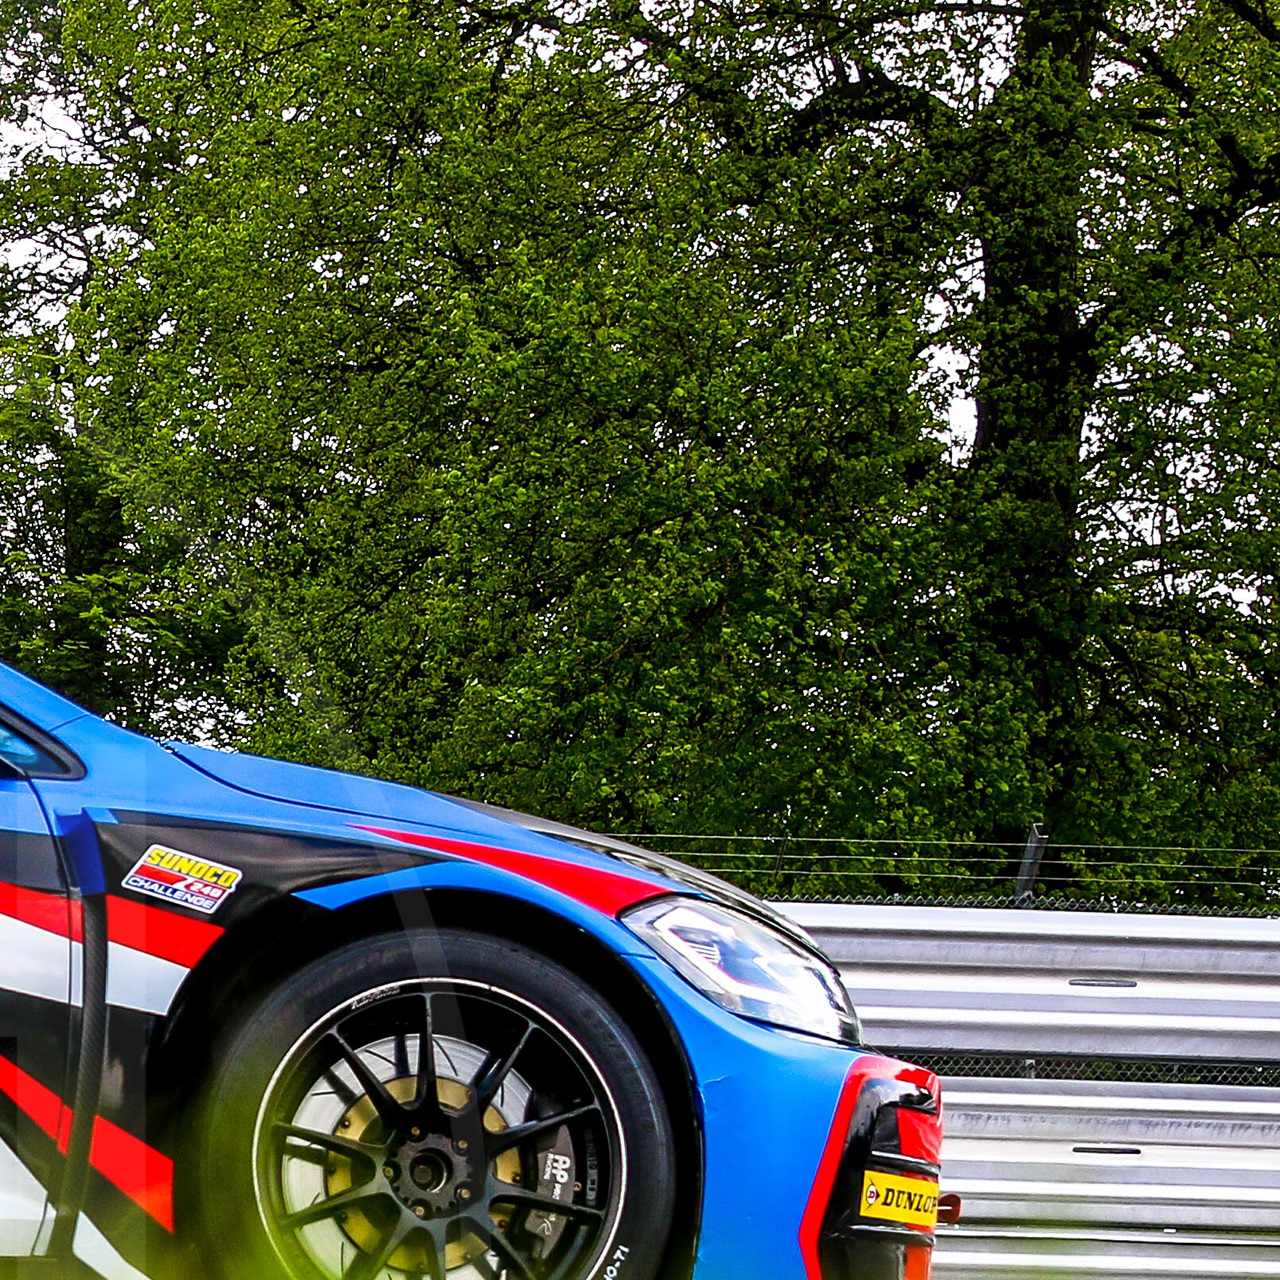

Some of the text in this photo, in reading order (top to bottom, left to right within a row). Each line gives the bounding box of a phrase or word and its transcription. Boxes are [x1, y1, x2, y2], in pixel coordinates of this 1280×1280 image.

[145, 847, 239, 888] SUNOCO
[127, 876, 216, 909] CHALLENGE
[189, 881, 225, 899] 240
[881, 1187, 938, 1214] DUNLOP
